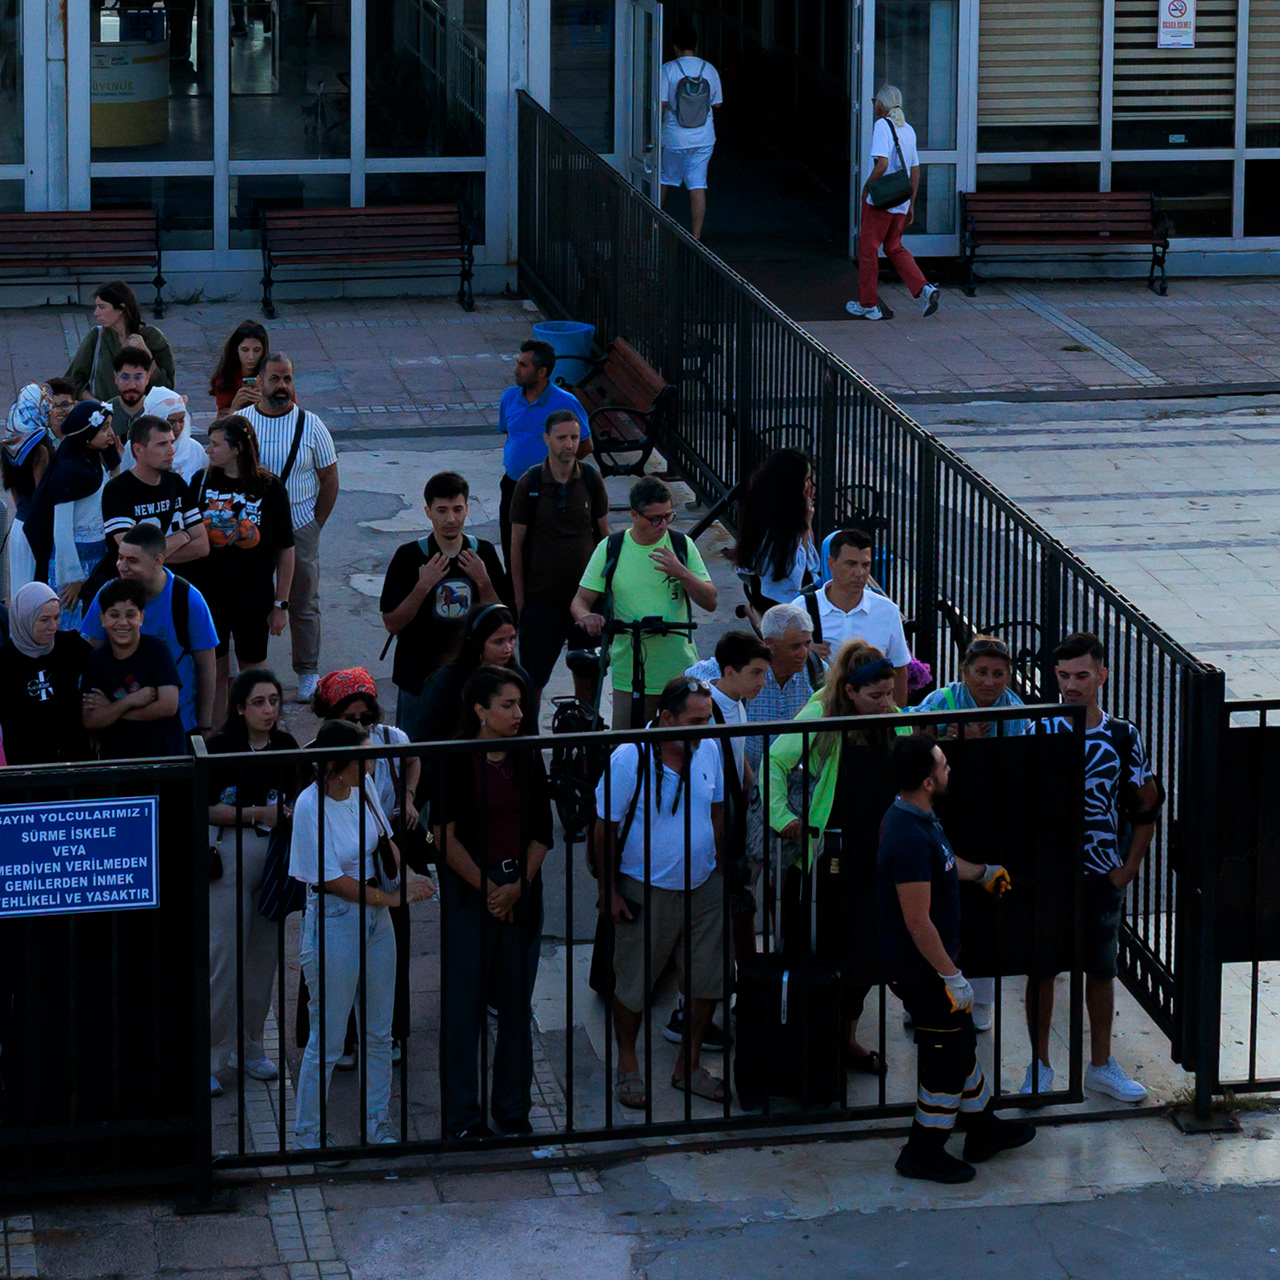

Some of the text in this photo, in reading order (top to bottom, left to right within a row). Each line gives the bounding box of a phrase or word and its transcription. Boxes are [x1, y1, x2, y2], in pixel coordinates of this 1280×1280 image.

[92, 80, 134, 91] ÜVENLİK
[133, 502, 155, 517] NEW
[40, 808, 141, 823] YOLCULARIMIZ
[21, 826, 117, 843] SÜRME İSKELE
[52, 845, 86, 857] VEYA
[65, 856, 148, 872] VERİLMEDEN
[4, 872, 134, 892] GEMİLERDEN İNMEK
[65, 892, 82, 904] VE
[86, 888, 150, 903] YASAKTIR
